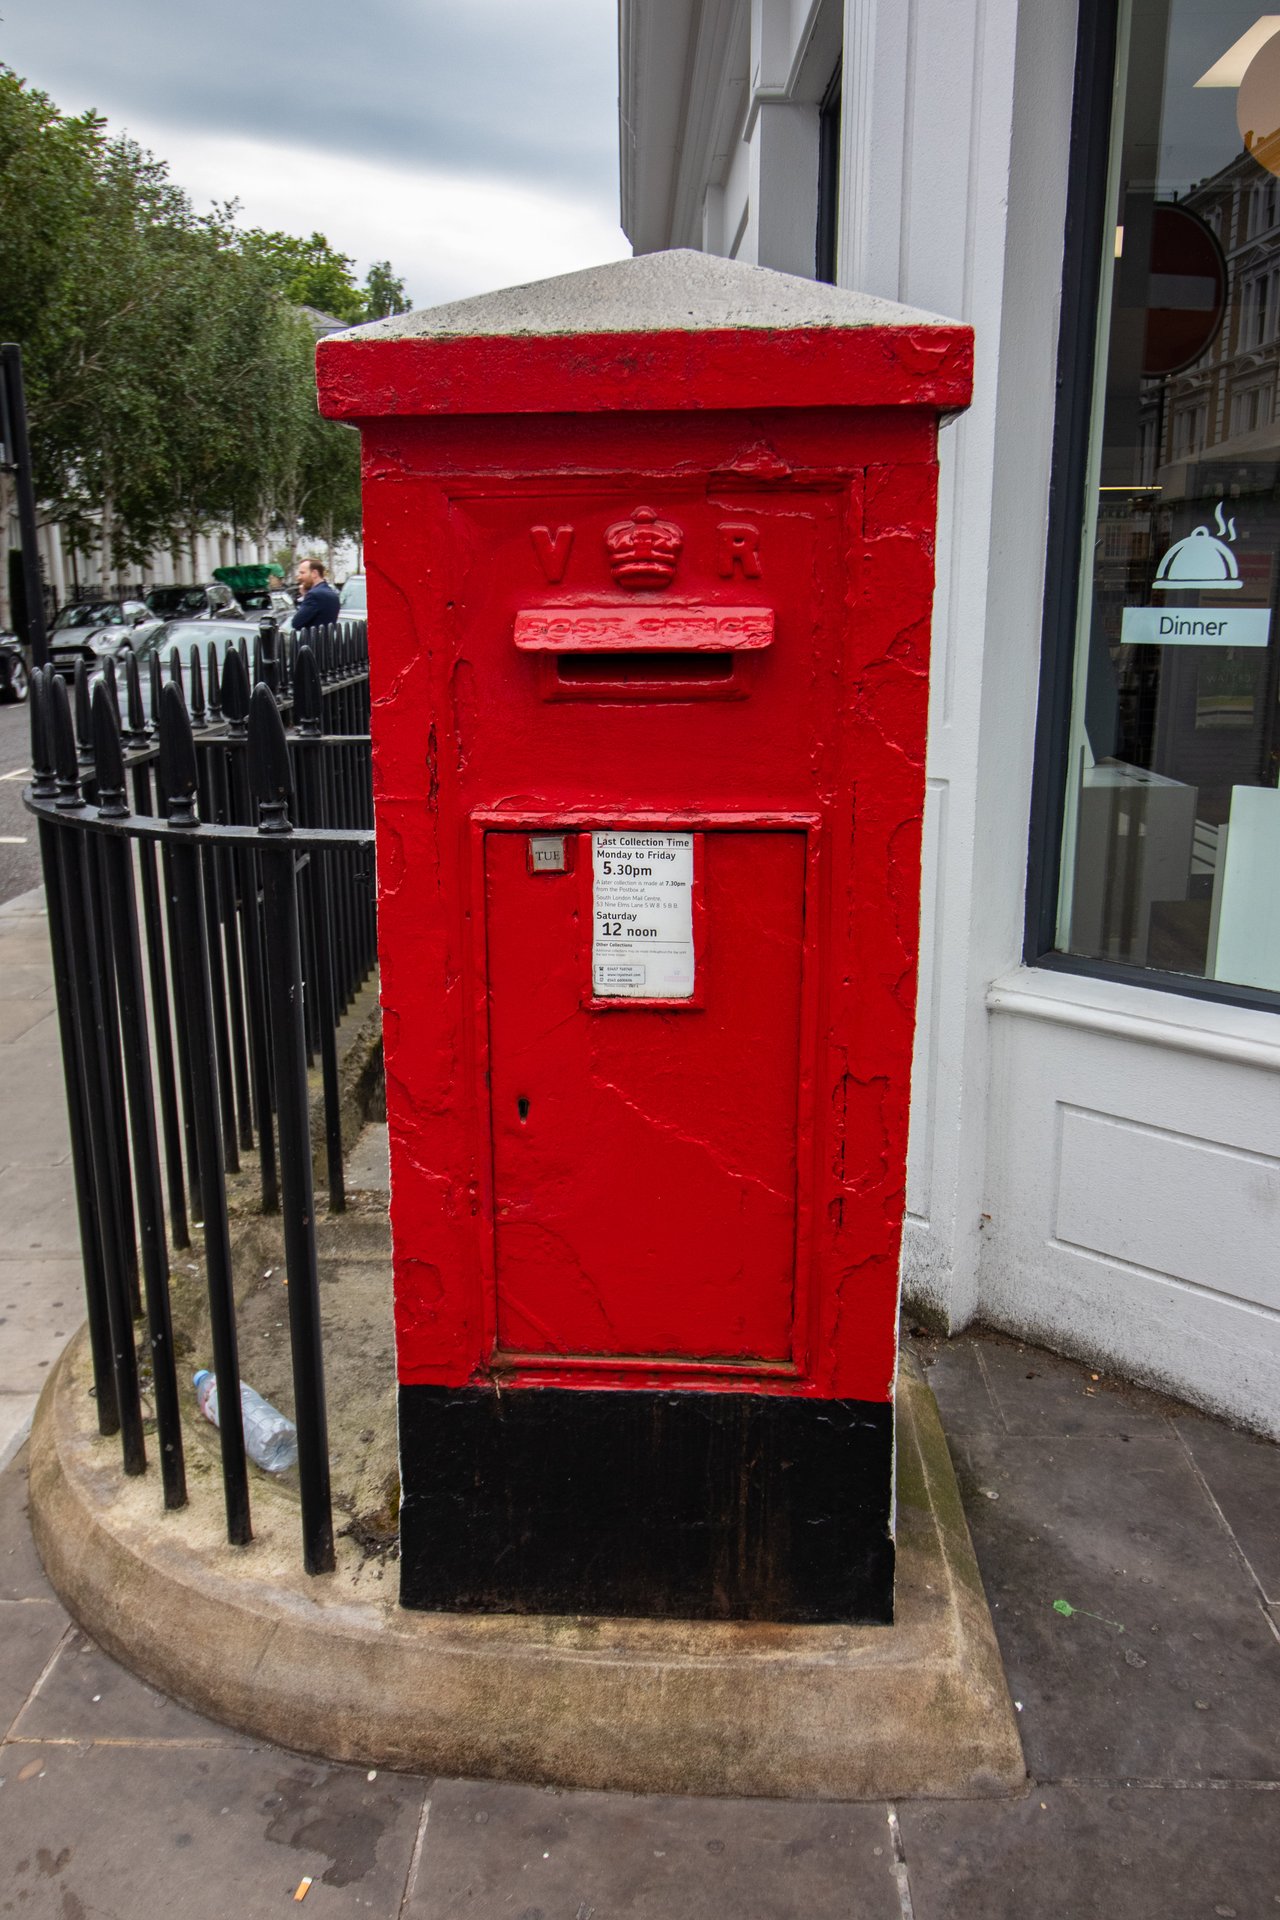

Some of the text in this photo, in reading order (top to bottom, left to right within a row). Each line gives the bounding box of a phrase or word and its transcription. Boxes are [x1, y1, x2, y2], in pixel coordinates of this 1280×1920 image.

[530, 521, 762, 584] V R
[1159, 615, 1228, 636] Dinner
[597, 837, 690, 847] Last Collection Time
[535, 851, 560, 861] TUE
[597, 850, 676, 861] Monday to Friday
[603, 861, 652, 877] 5.30pm
[596, 911, 637, 921] Saturday
[602, 922, 657, 937] 12 noon
